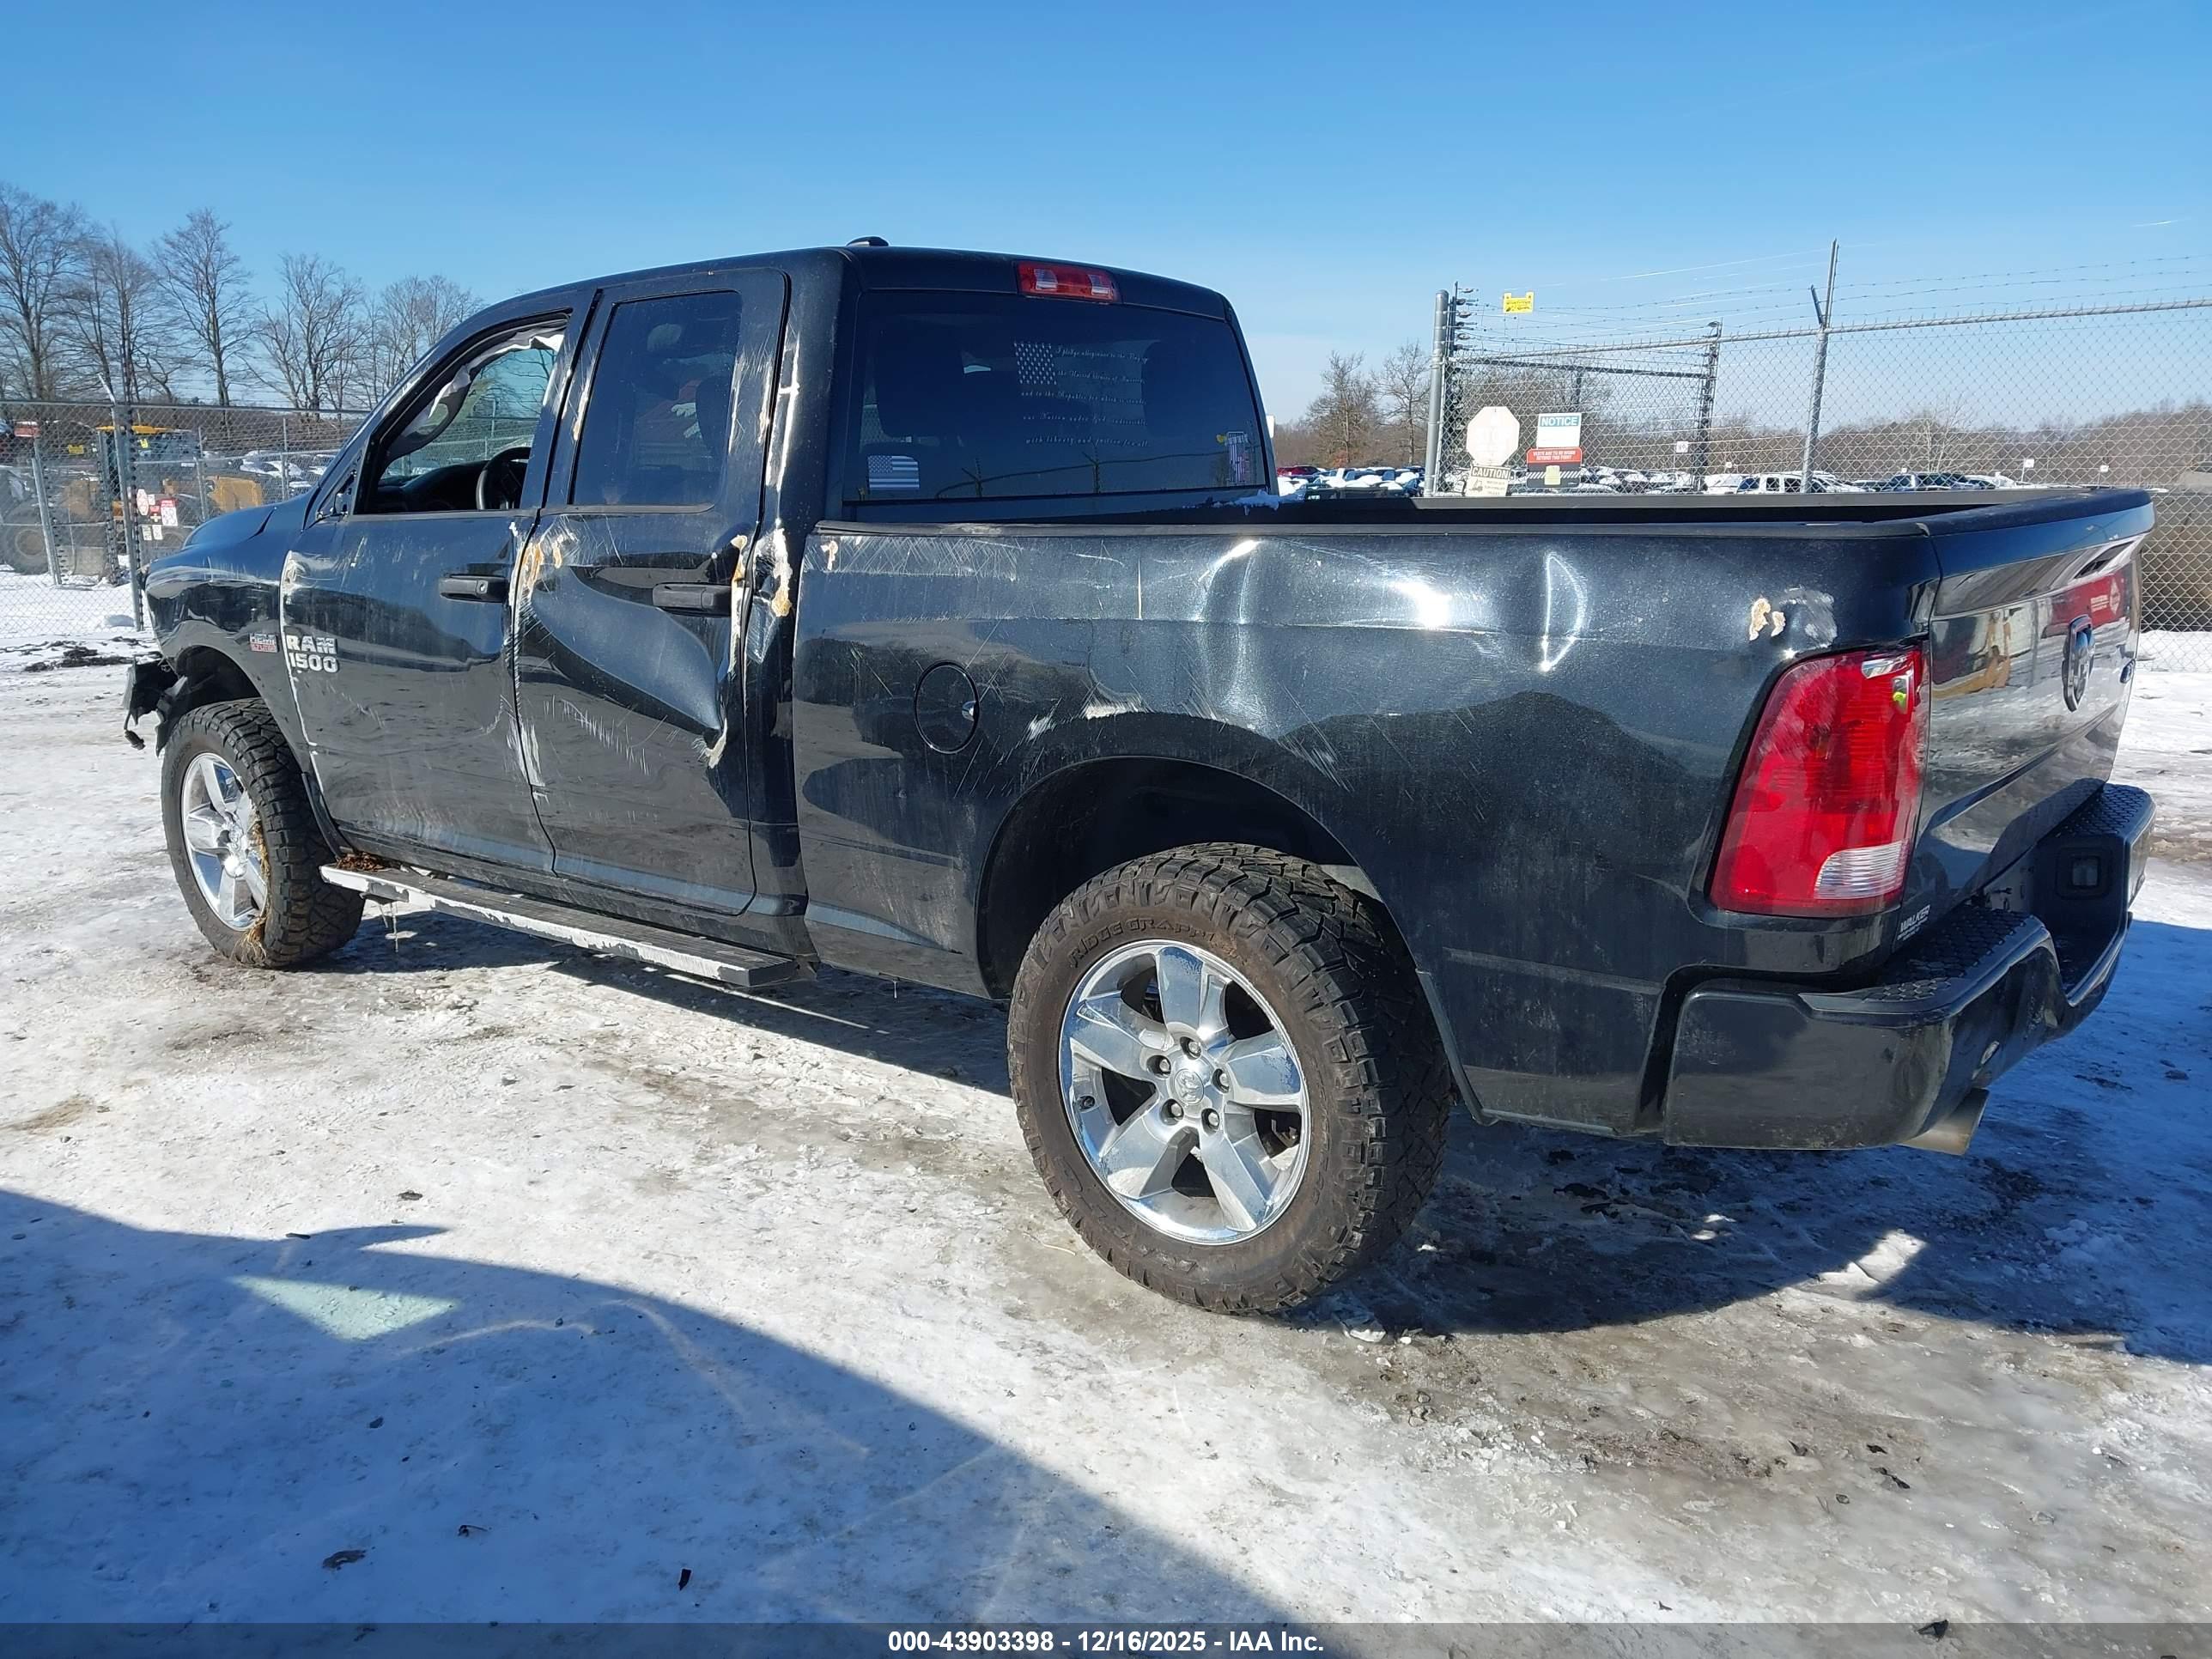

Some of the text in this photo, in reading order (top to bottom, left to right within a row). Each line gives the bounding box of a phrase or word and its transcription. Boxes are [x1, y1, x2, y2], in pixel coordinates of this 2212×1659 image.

[1541, 416, 1577, 427] NOTICE
[1472, 467, 1509, 480] CAUTION
[286, 635, 337, 654] RAM
[289, 653, 339, 673] 1500
[1068, 919, 1123, 968] RIDGE
